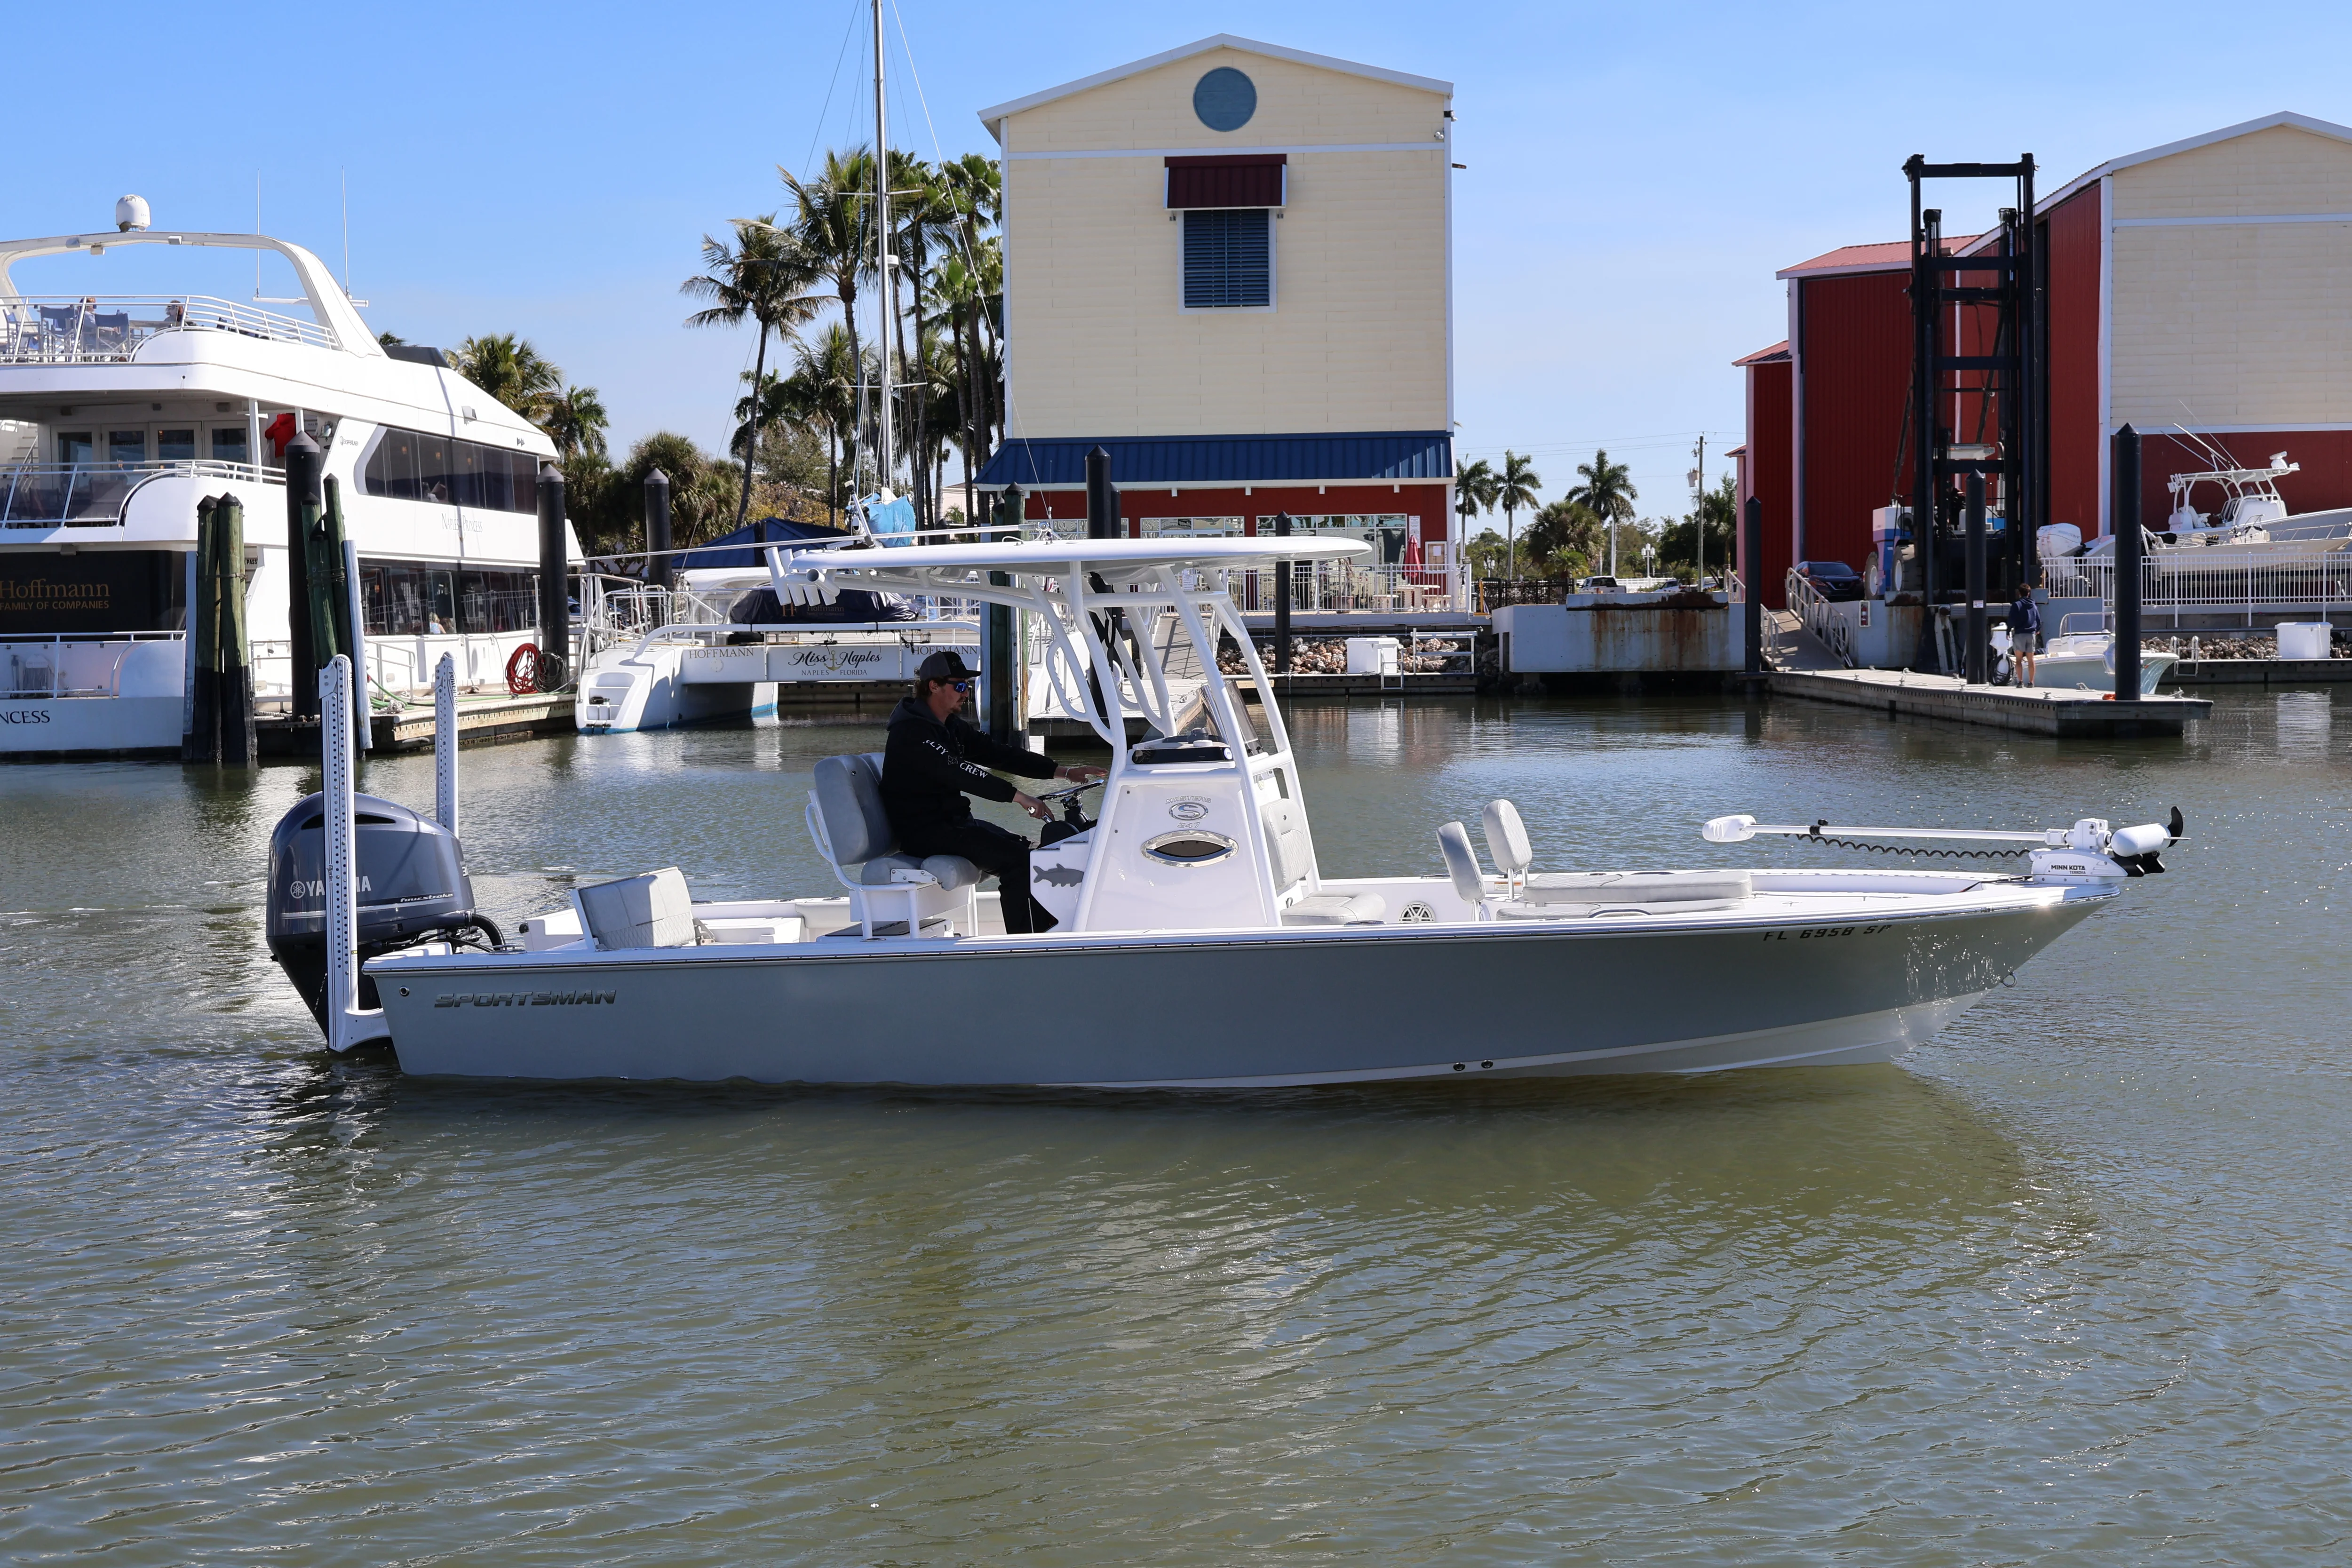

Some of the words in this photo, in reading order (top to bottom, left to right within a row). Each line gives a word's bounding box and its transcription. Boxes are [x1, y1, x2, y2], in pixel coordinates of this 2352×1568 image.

[462, 515, 483, 533] PRINCESS
[0, 578, 111, 599] Hoffmann
[0, 602, 34, 611] FAMILY
[36, 601, 49, 610] OF
[52, 600, 110, 610] COMPANIES
[688, 647, 755, 659] HOFFMANN
[788, 651, 829, 667] Miss
[835, 651, 882, 669] Naples
[960, 762, 988, 779] CREW
[1165, 795, 1212, 805] MASTERS
[1763, 931, 1787, 941] FL
[1799, 927, 1855, 939] 6958
[434, 989, 617, 1008] SPORTSMAN
